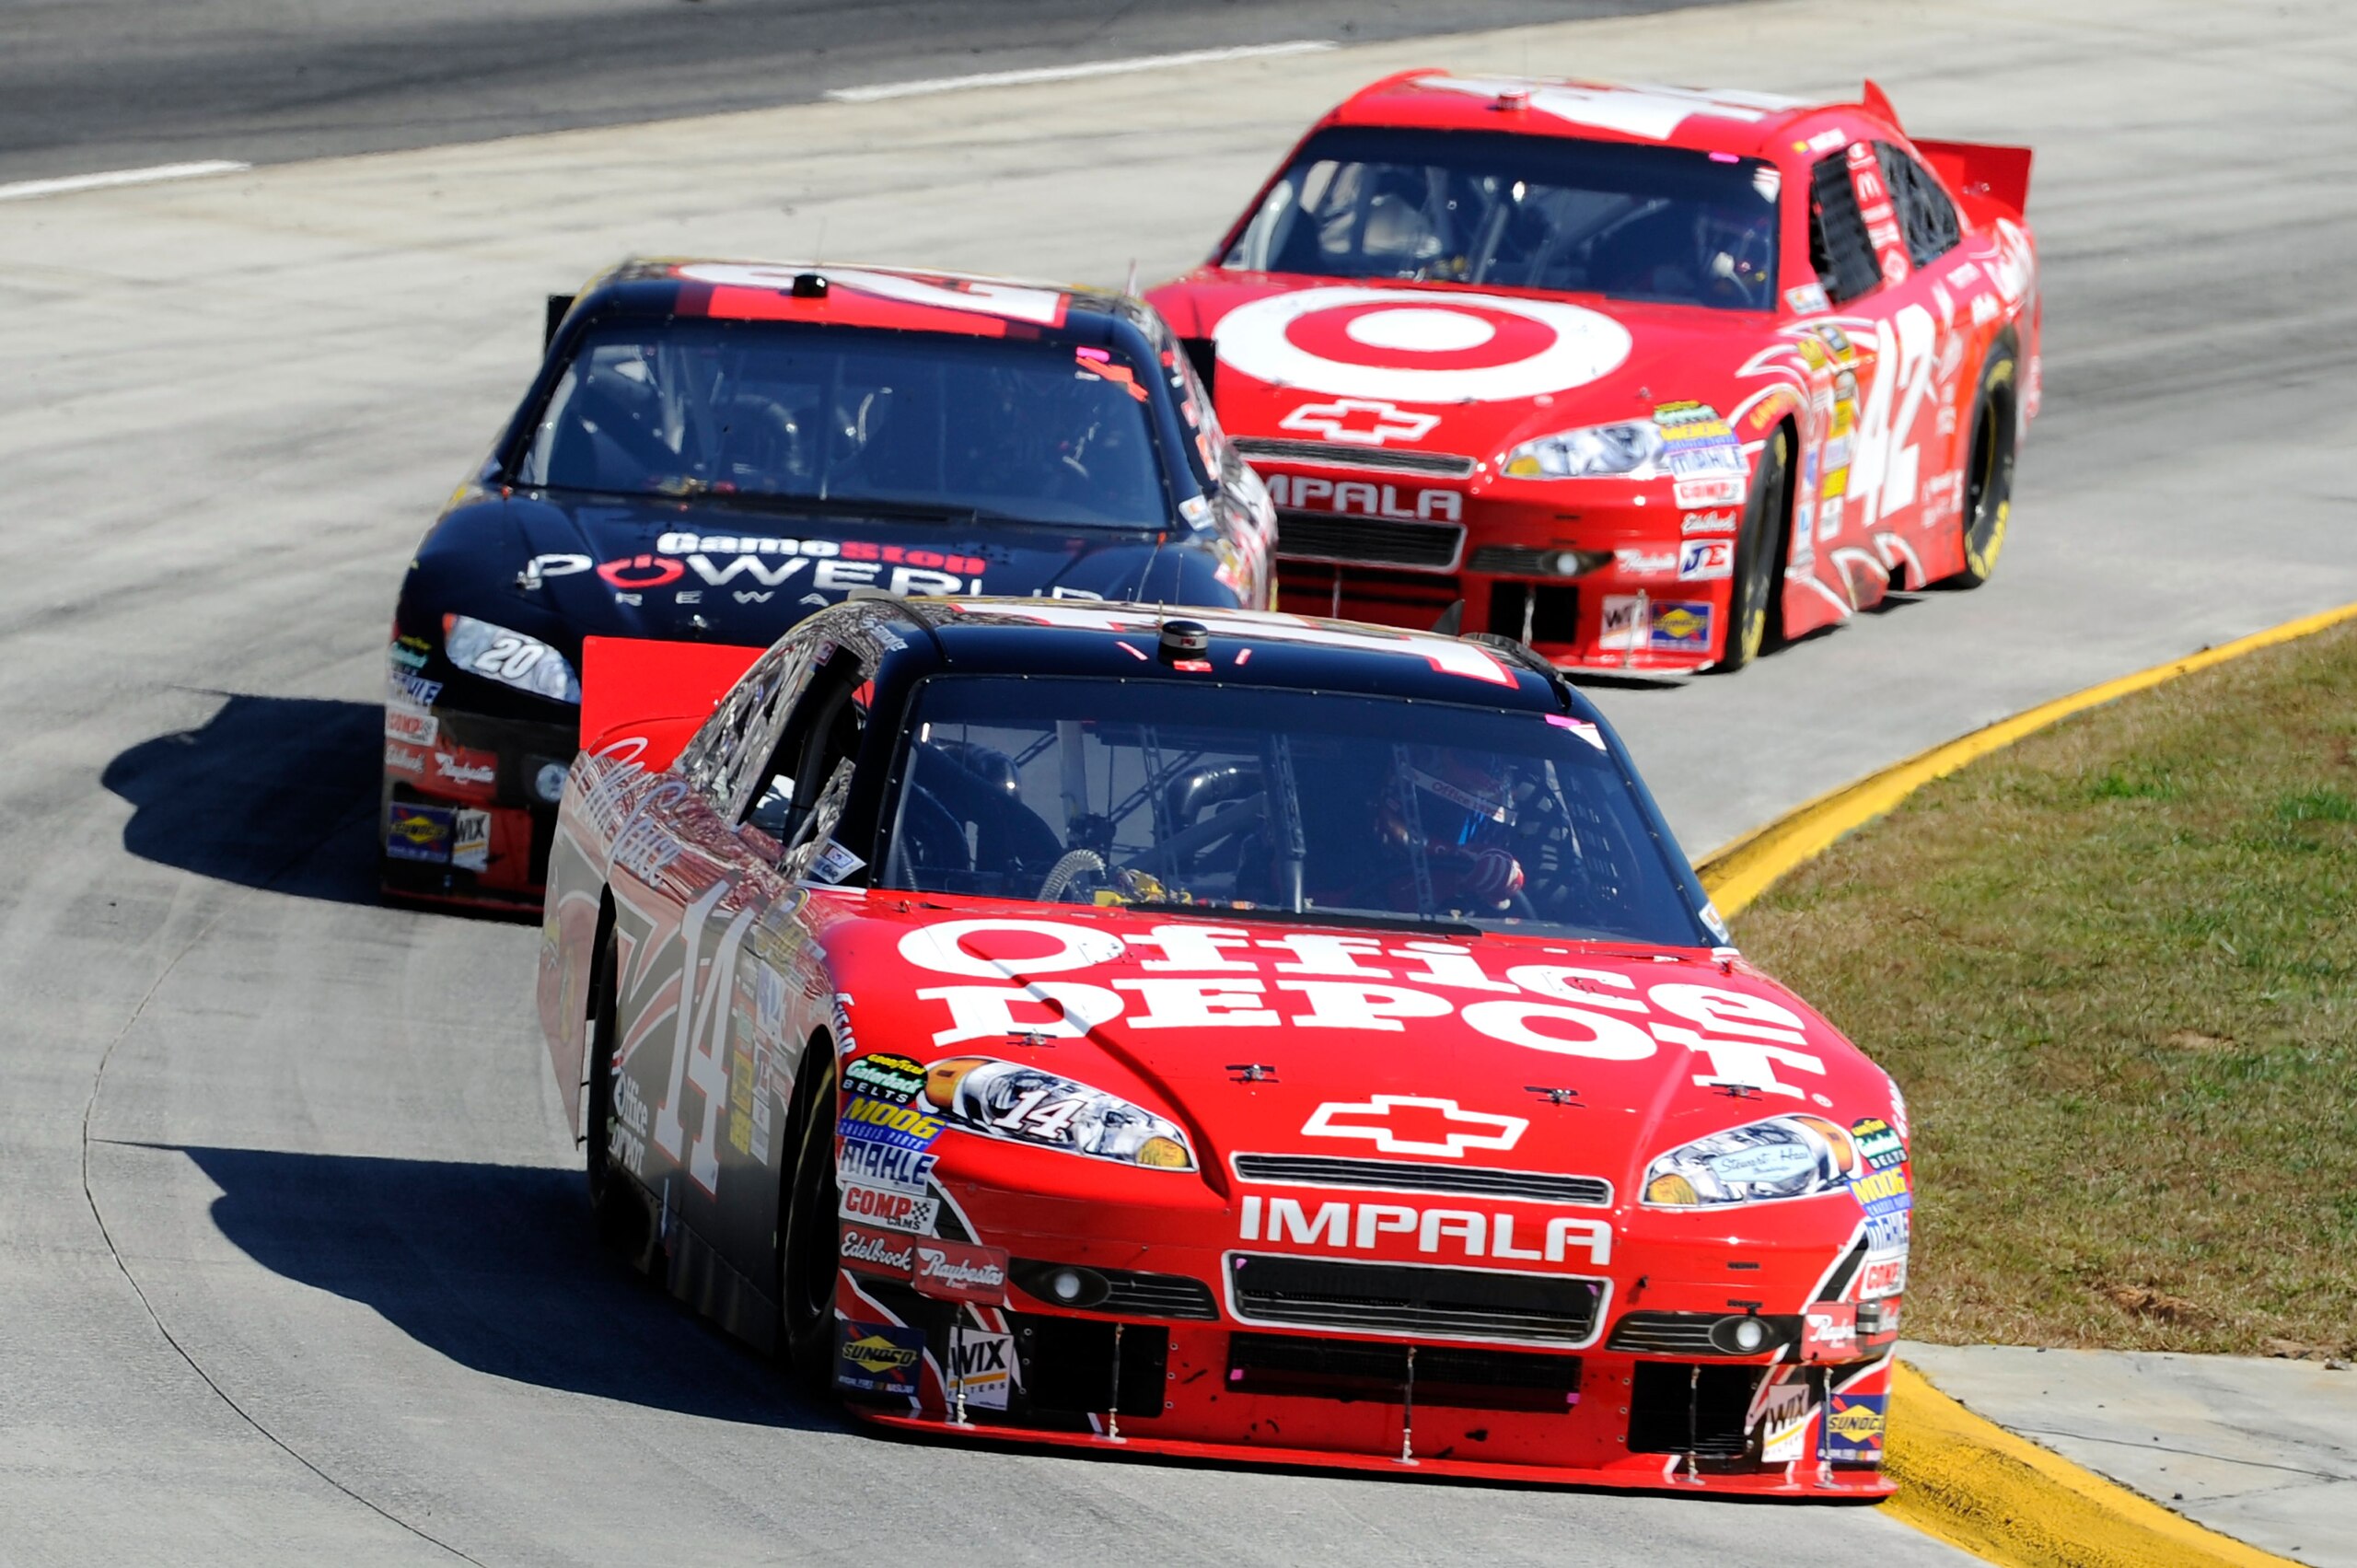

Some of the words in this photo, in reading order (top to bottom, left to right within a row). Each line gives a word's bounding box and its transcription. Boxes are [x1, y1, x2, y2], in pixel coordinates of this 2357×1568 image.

[1847, 303, 1937, 528] 42
[656, 531, 986, 575] GameStop
[527, 553, 1105, 600] POWER
[473, 637, 545, 679] 20
[897, 918, 1809, 1047] Office
[653, 877, 759, 1199] 14
[915, 976, 1827, 1101] DEPOT
[842, 1078, 909, 1104] BELTS
[845, 1059, 924, 1094] Gatorback
[842, 1096, 947, 1140] MOOG
[992, 1088, 1088, 1141] 14
[842, 1136, 936, 1186] MAHLE
[845, 1186, 912, 1219] COMP
[1851, 1167, 1908, 1206] MOOG
[886, 1216, 922, 1231] CAMS
[1239, 1195, 1612, 1266] IMPALA
[840, 1231, 913, 1272] Edelbrock
[917, 1247, 1005, 1286] Raybestos
[843, 1343, 919, 1367] SUNOCO
[950, 1337, 1011, 1376] WIX
[947, 1382, 1006, 1399] FTERS
